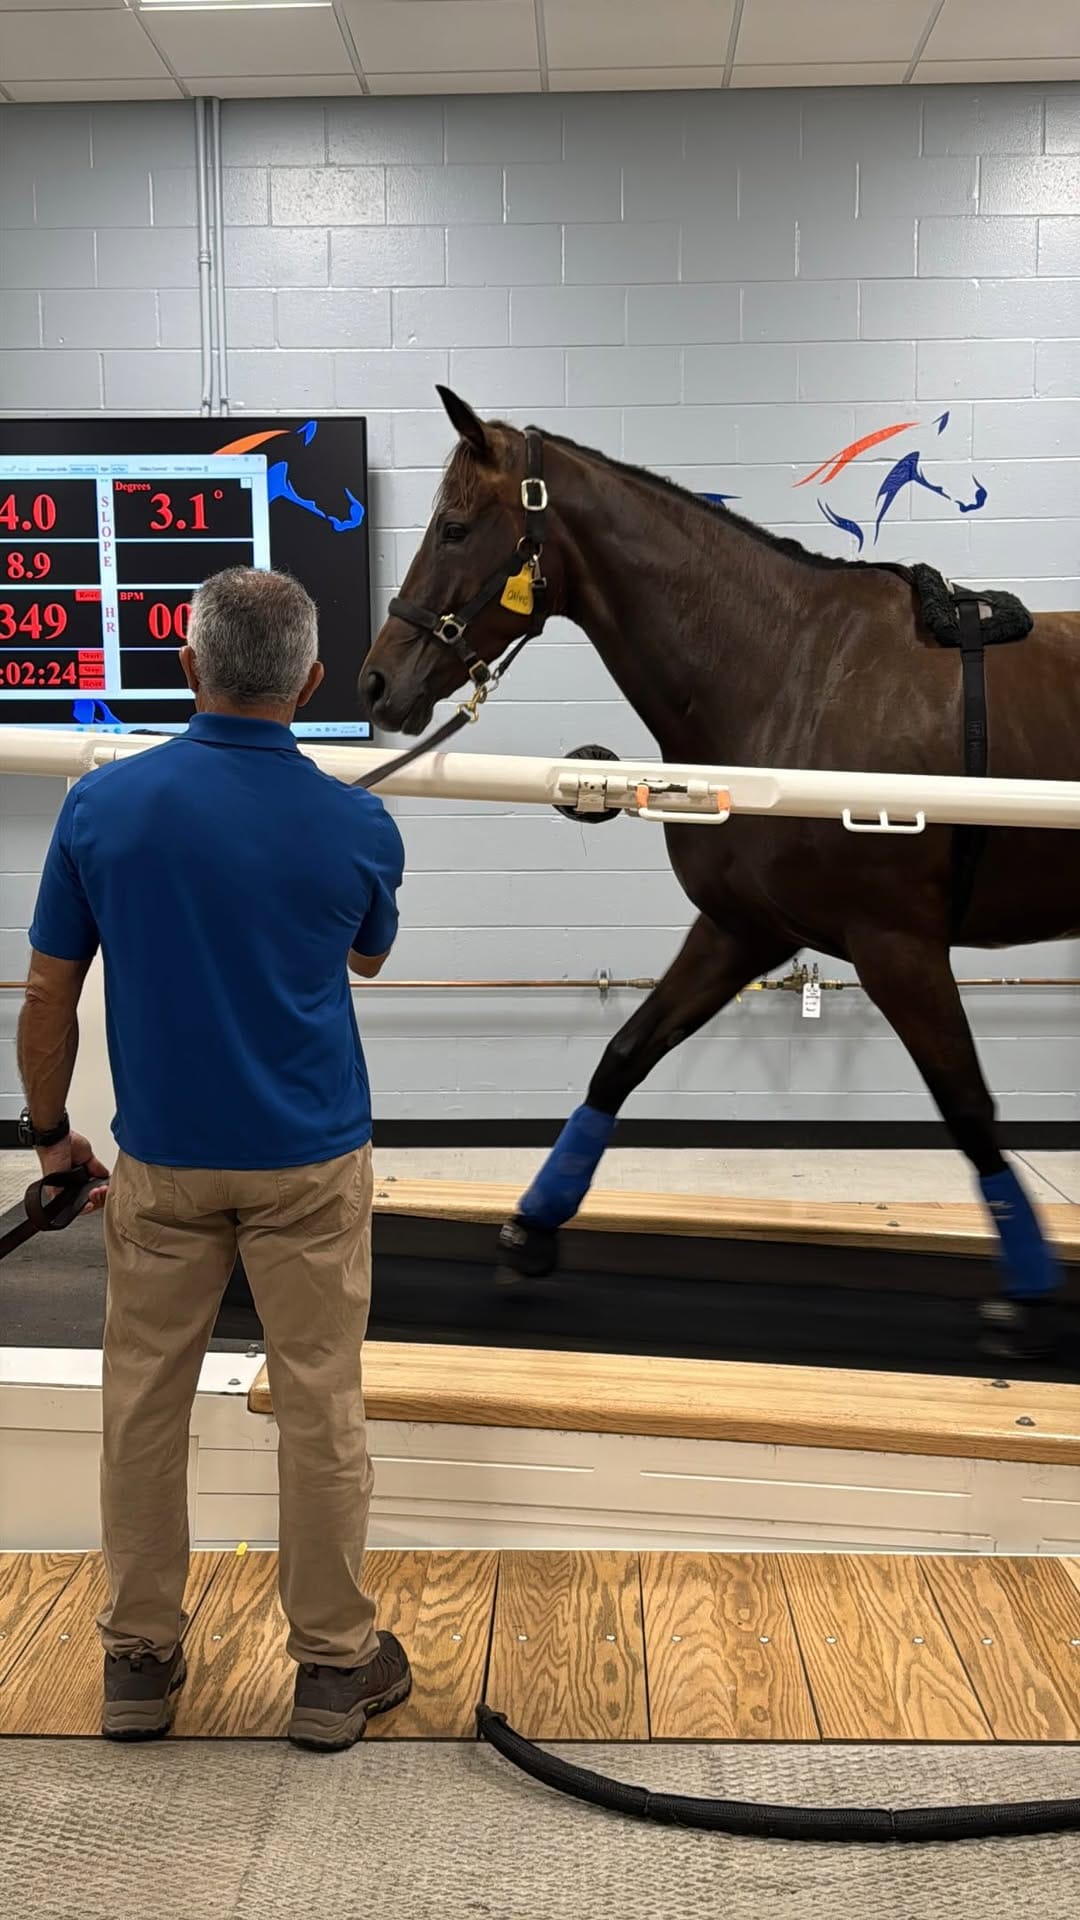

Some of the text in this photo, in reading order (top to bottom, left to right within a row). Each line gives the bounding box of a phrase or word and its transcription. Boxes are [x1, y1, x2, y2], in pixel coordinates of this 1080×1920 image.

[115, 481, 151, 493] Degrees
[101, 496, 112, 567] SLOPE
[7, 552, 51, 579] 8.9
[120, 592, 144, 600] BPM
[106, 607, 115, 632] HR
